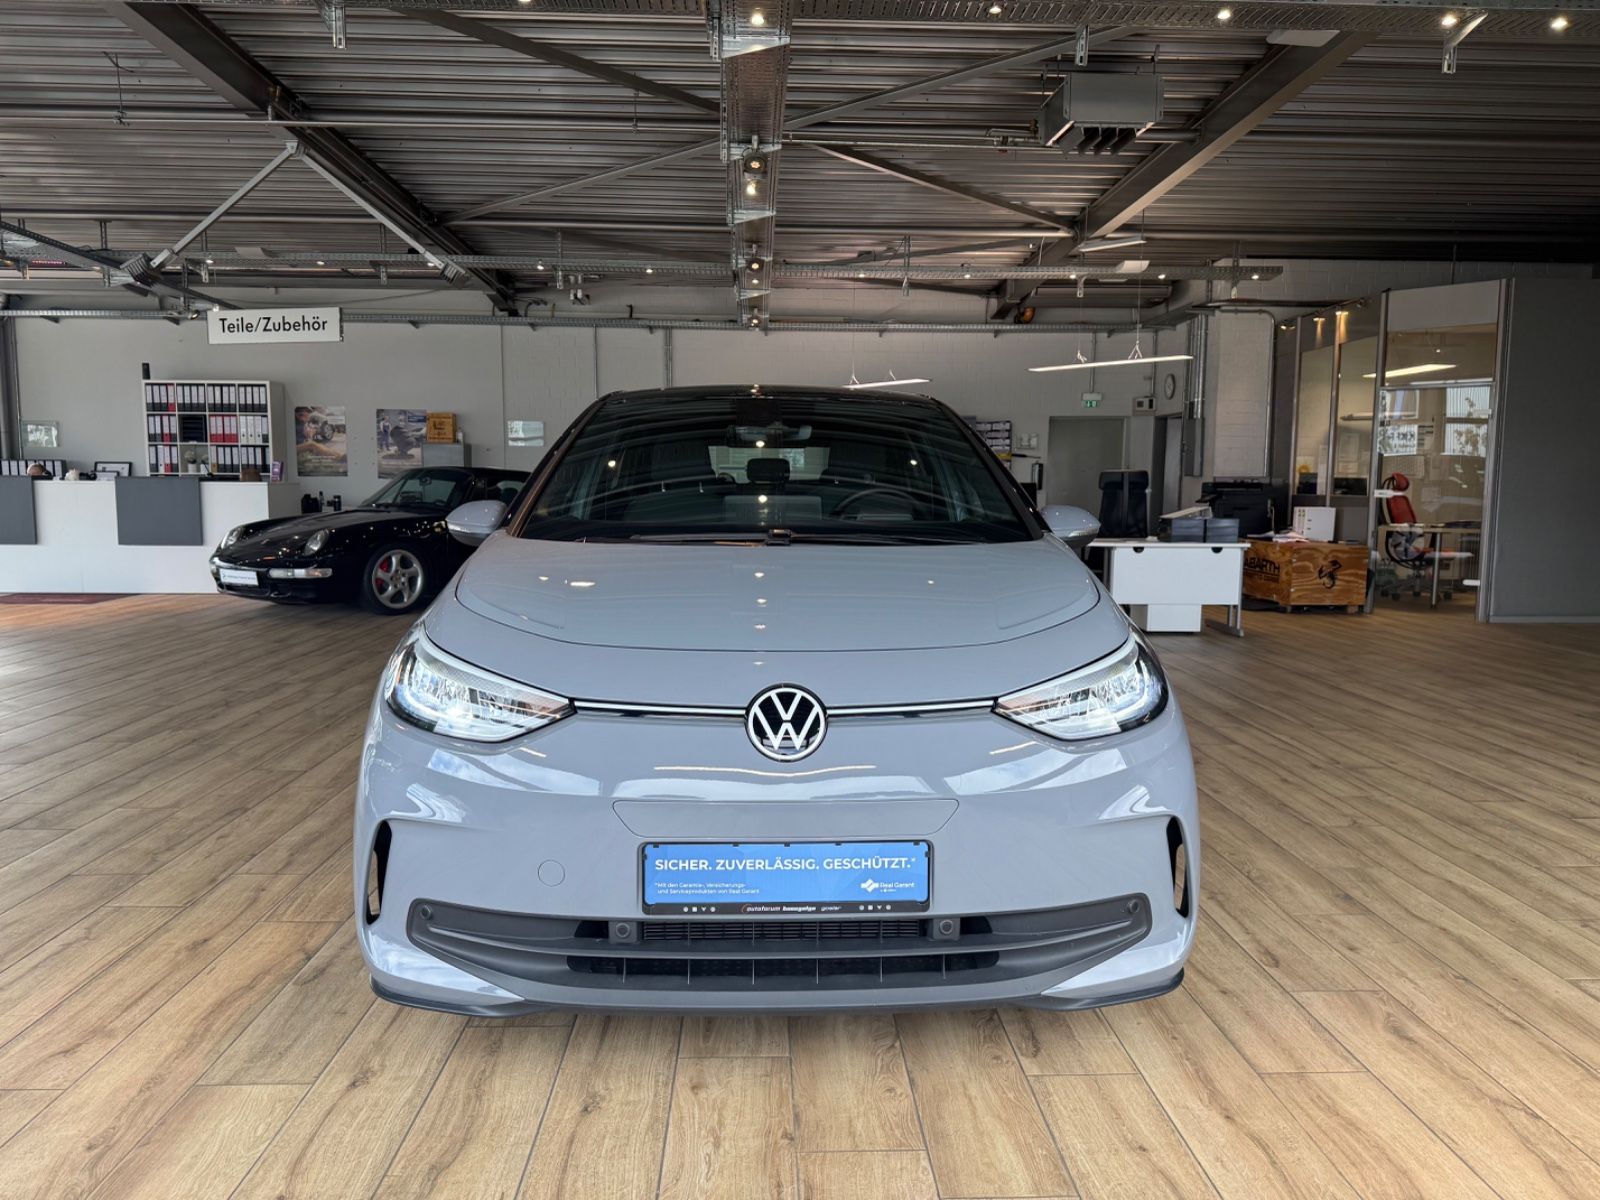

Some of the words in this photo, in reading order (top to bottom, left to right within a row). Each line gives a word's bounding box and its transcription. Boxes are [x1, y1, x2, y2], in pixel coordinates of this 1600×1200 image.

[219, 315, 328, 333] Teile/Zubehör
[655, 859, 712, 871] SICHER.
[715, 856, 819, 871] ZUVERLÄSSIG.
